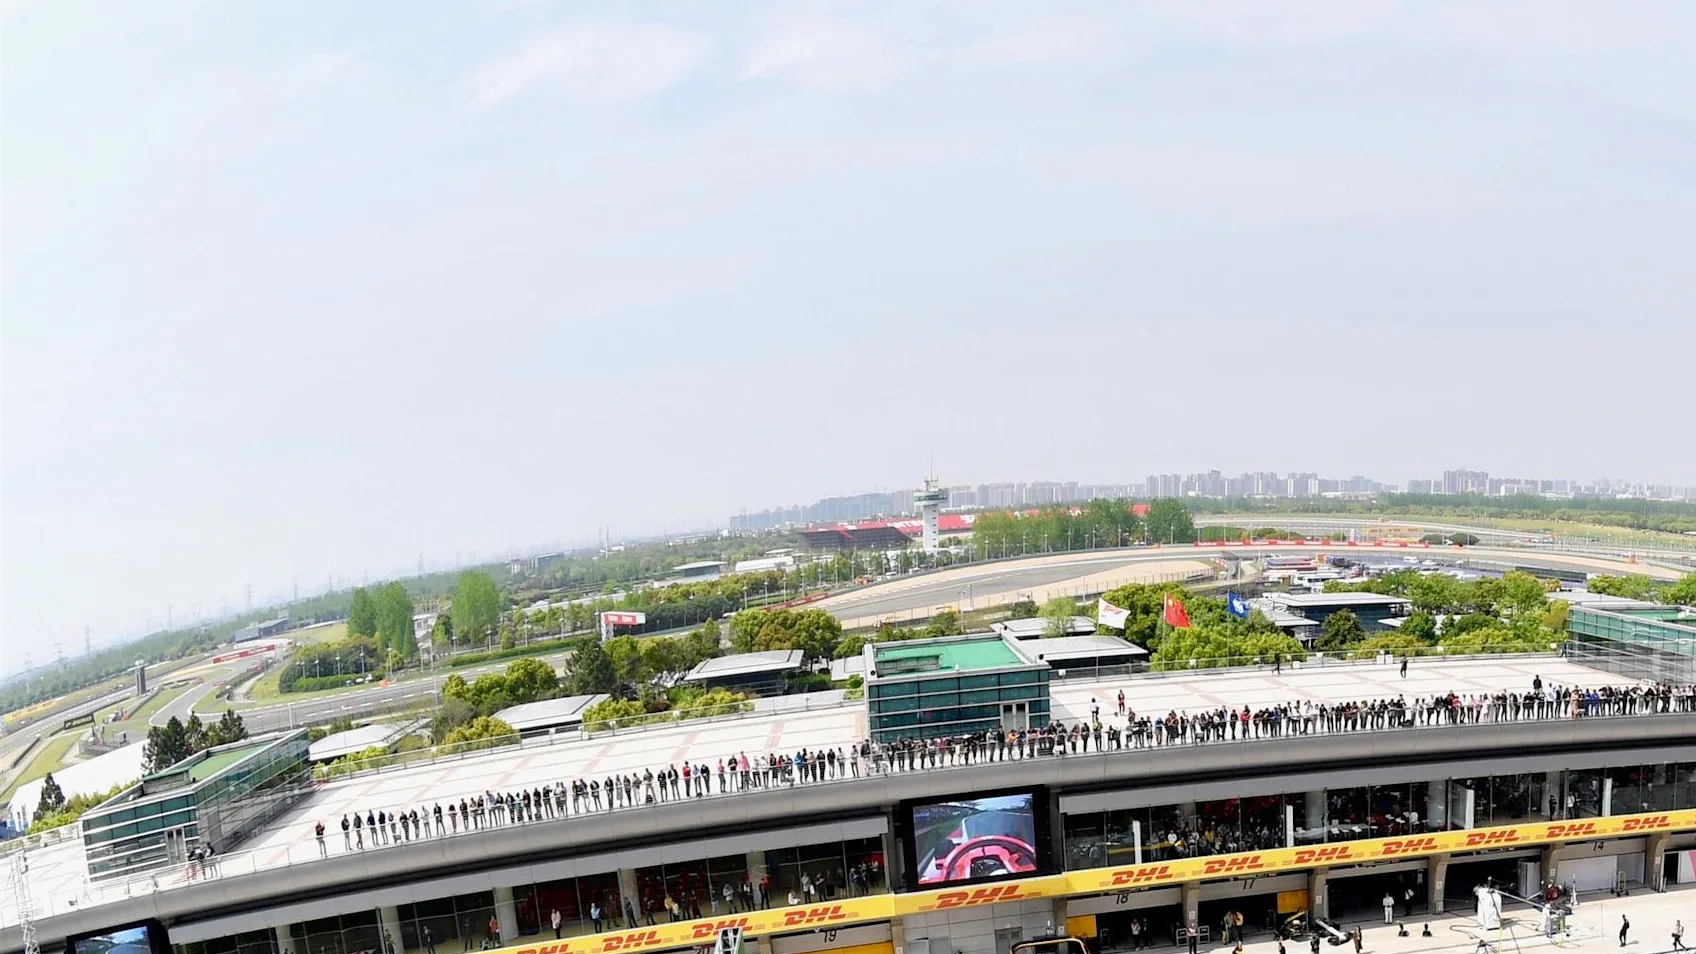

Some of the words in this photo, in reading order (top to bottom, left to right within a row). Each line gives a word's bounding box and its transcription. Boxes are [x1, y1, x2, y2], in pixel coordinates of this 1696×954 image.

[1546, 822, 1597, 838] DHL
[1622, 815, 1671, 831] DHL
[1382, 837, 1439, 855] DHL
[1466, 829, 1520, 846] DHL
[1593, 841, 1604, 851] 14
[1204, 854, 1265, 874] DHL
[1294, 846, 1353, 864] DHL
[1111, 865, 1174, 886] DHL
[1243, 879, 1255, 890] 17
[935, 884, 1025, 909] DHL
[1116, 892, 1129, 904] 18
[784, 905, 847, 926] DHL
[692, 917, 753, 939] DHL
[824, 929, 837, 943] 19
[603, 930, 662, 952] DHL
